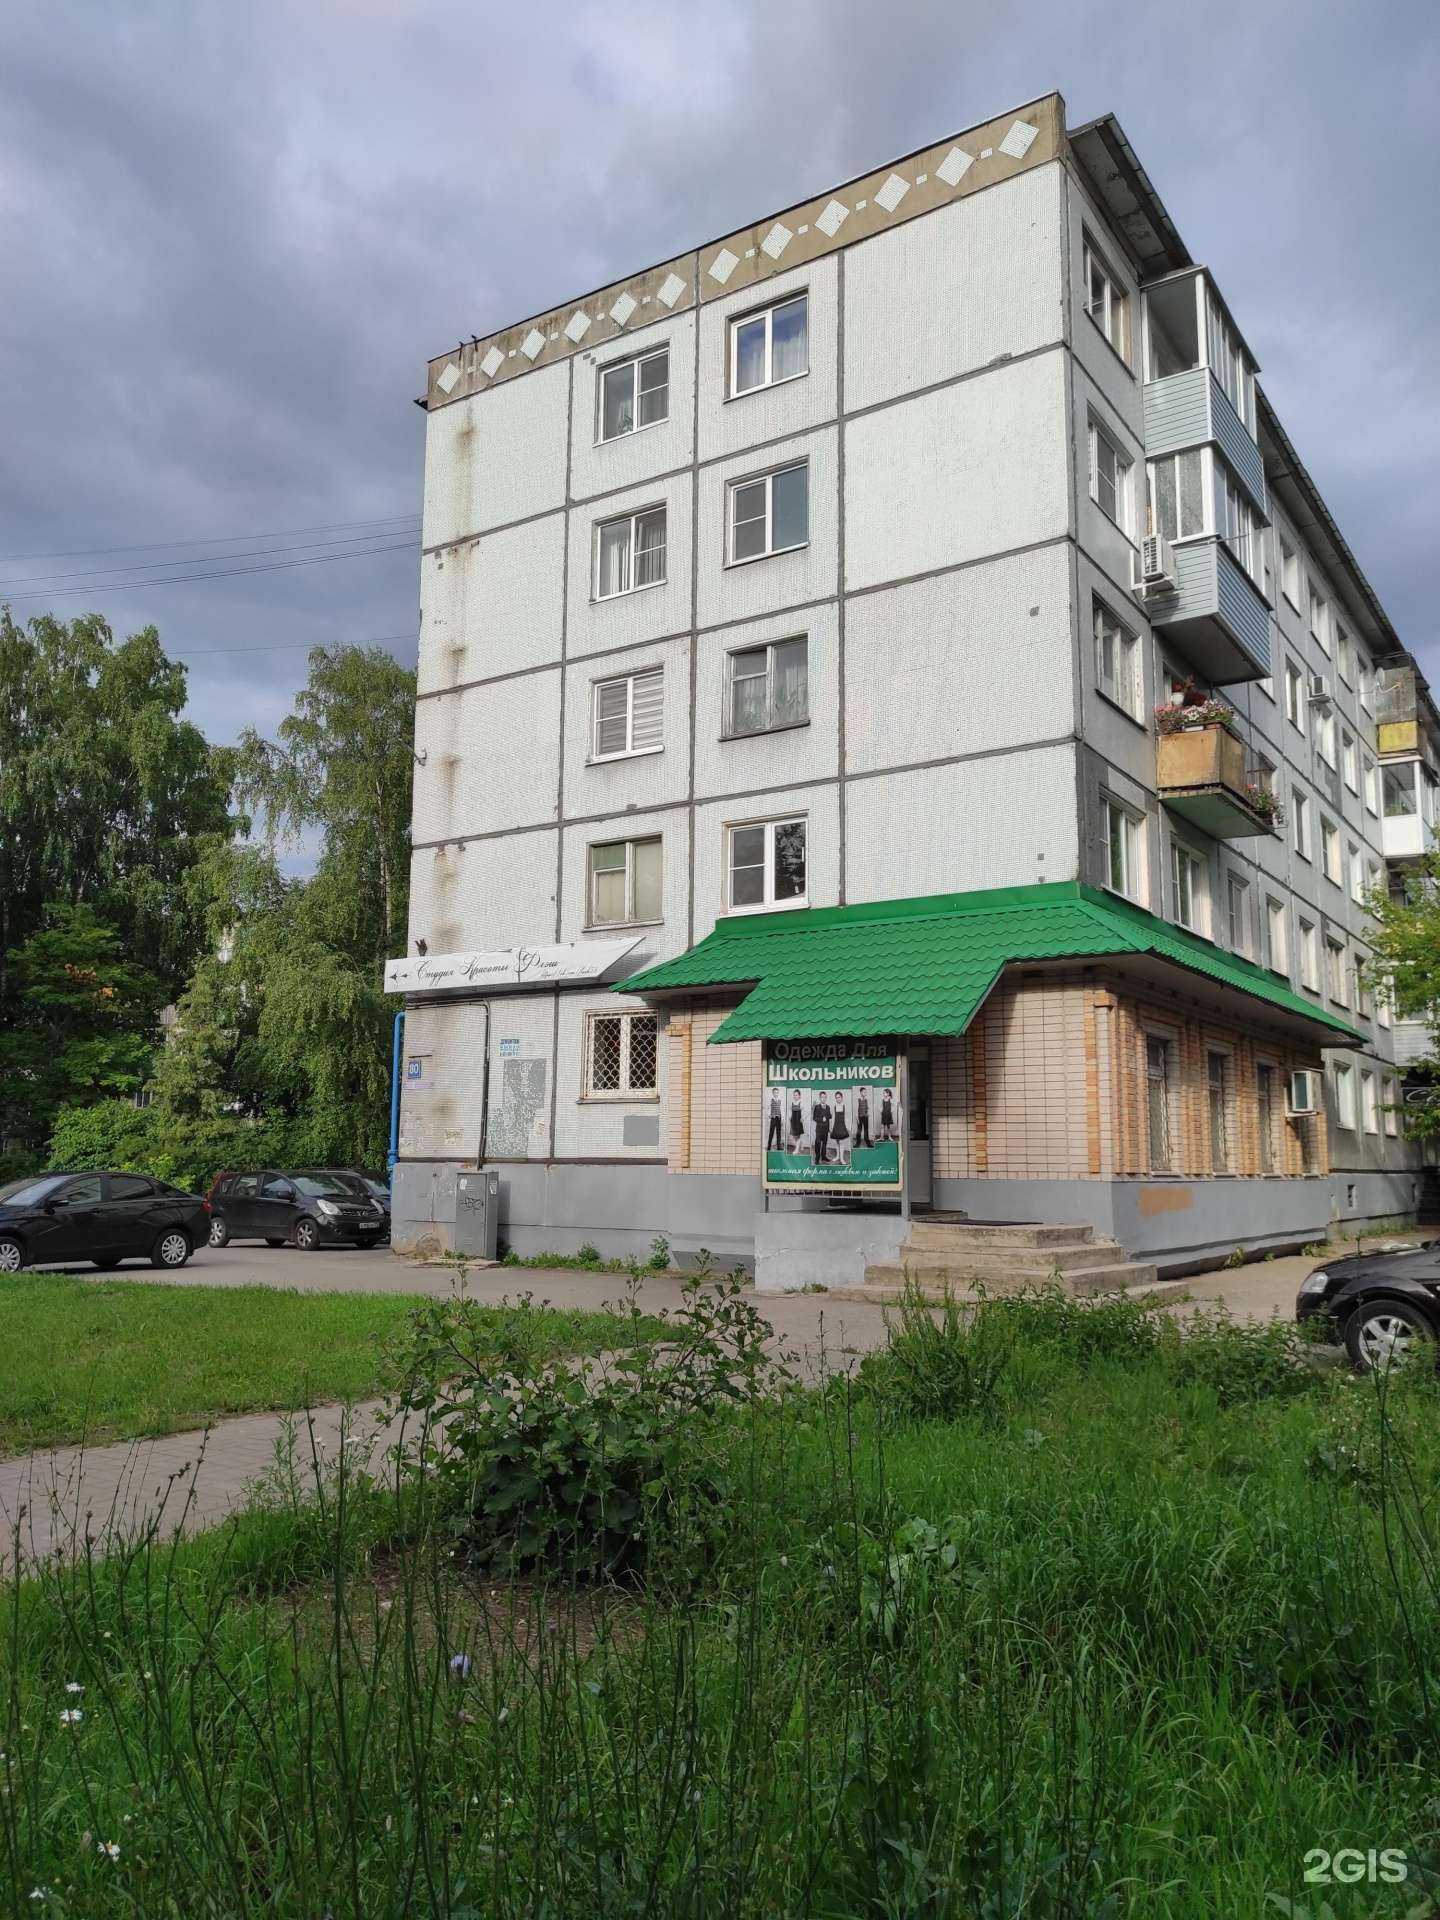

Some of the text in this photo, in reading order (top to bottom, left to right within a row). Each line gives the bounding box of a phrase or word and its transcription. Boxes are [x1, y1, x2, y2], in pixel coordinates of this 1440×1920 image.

[775, 1042, 888, 1061] Одежда Для
[768, 1063, 895, 1081] Школьников
